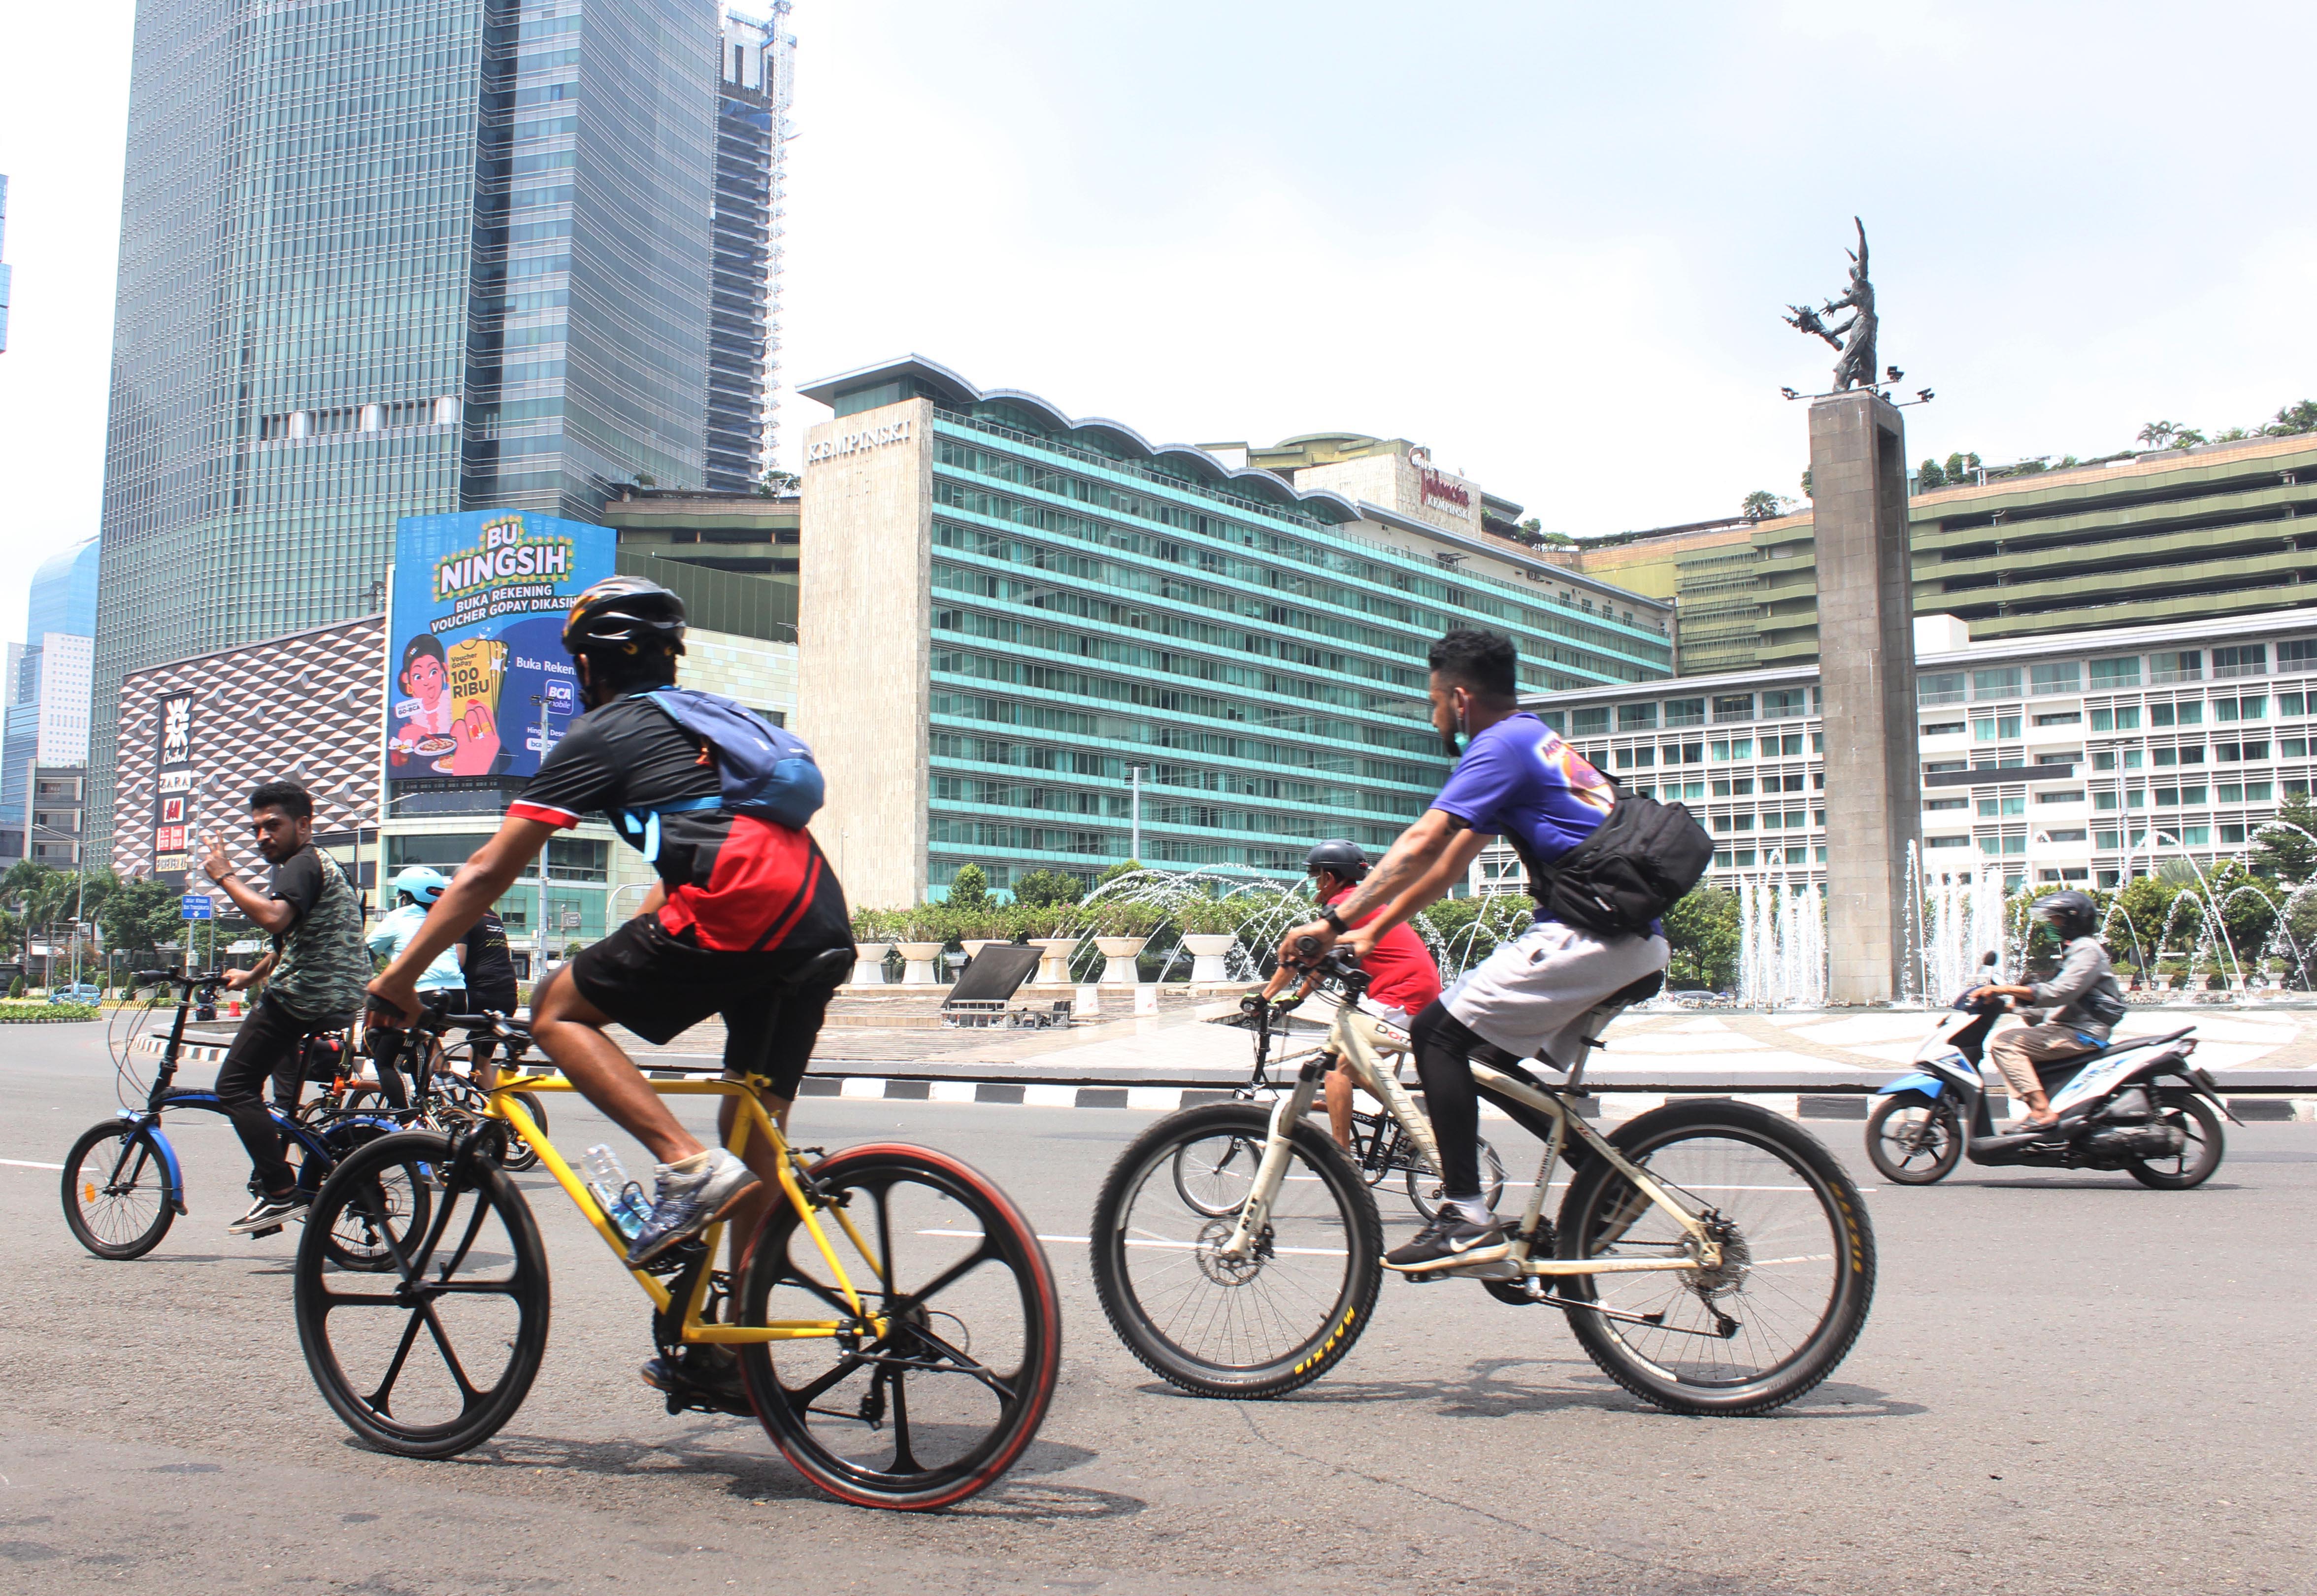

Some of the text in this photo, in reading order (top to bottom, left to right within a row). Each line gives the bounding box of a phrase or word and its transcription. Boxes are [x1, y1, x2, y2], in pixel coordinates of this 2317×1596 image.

[808, 420, 910, 461] KEMPINSKI
[1426, 494, 1470, 520] KEMPINSKI
[487, 523, 517, 550] BU
[441, 545, 566, 594] NINGSIH
[456, 585, 552, 613] BUKA REKENING
[430, 607, 486, 633] VOUCHER
[489, 600, 529, 615] GOPAY
[451, 653, 477, 663] Voucher
[452, 661, 473, 669] GoPay
[517, 657, 576, 675] Buka Reken
[451, 667, 479, 684] 100
[453, 679, 490, 698] RIBU
[548, 686, 571, 700] BCA
[528, 727, 548, 736] Hing
[159, 777, 189, 788] ZARA
[1294, 1306, 1355, 1375] MAXXIS
